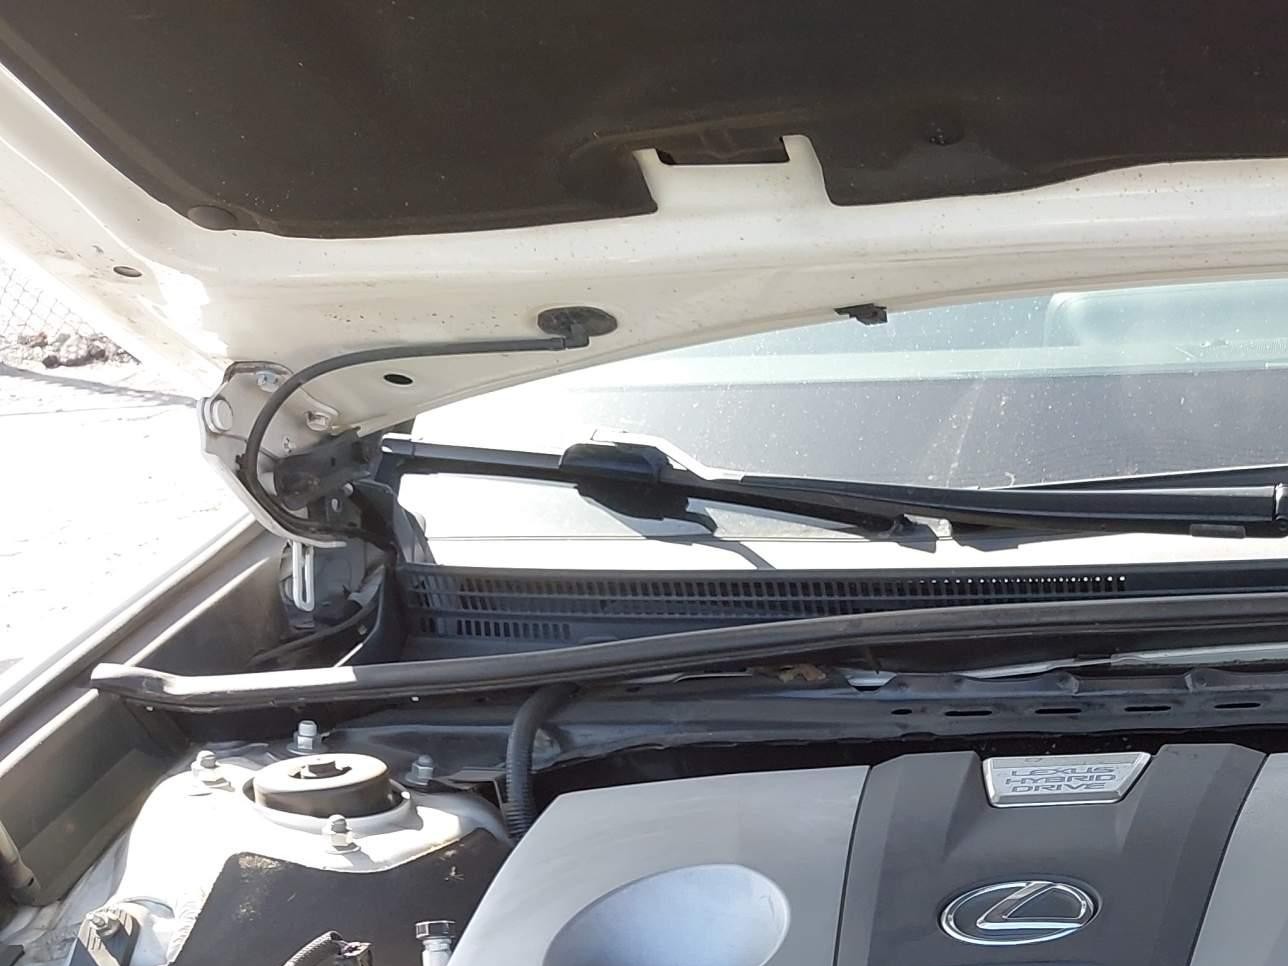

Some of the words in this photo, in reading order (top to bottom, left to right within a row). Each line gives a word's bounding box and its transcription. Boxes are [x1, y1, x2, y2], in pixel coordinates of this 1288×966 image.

[1011, 766, 1114, 777] LEXUS
[1005, 774, 1117, 785] HYBRID
[1011, 782, 1106, 793] DRIVE
